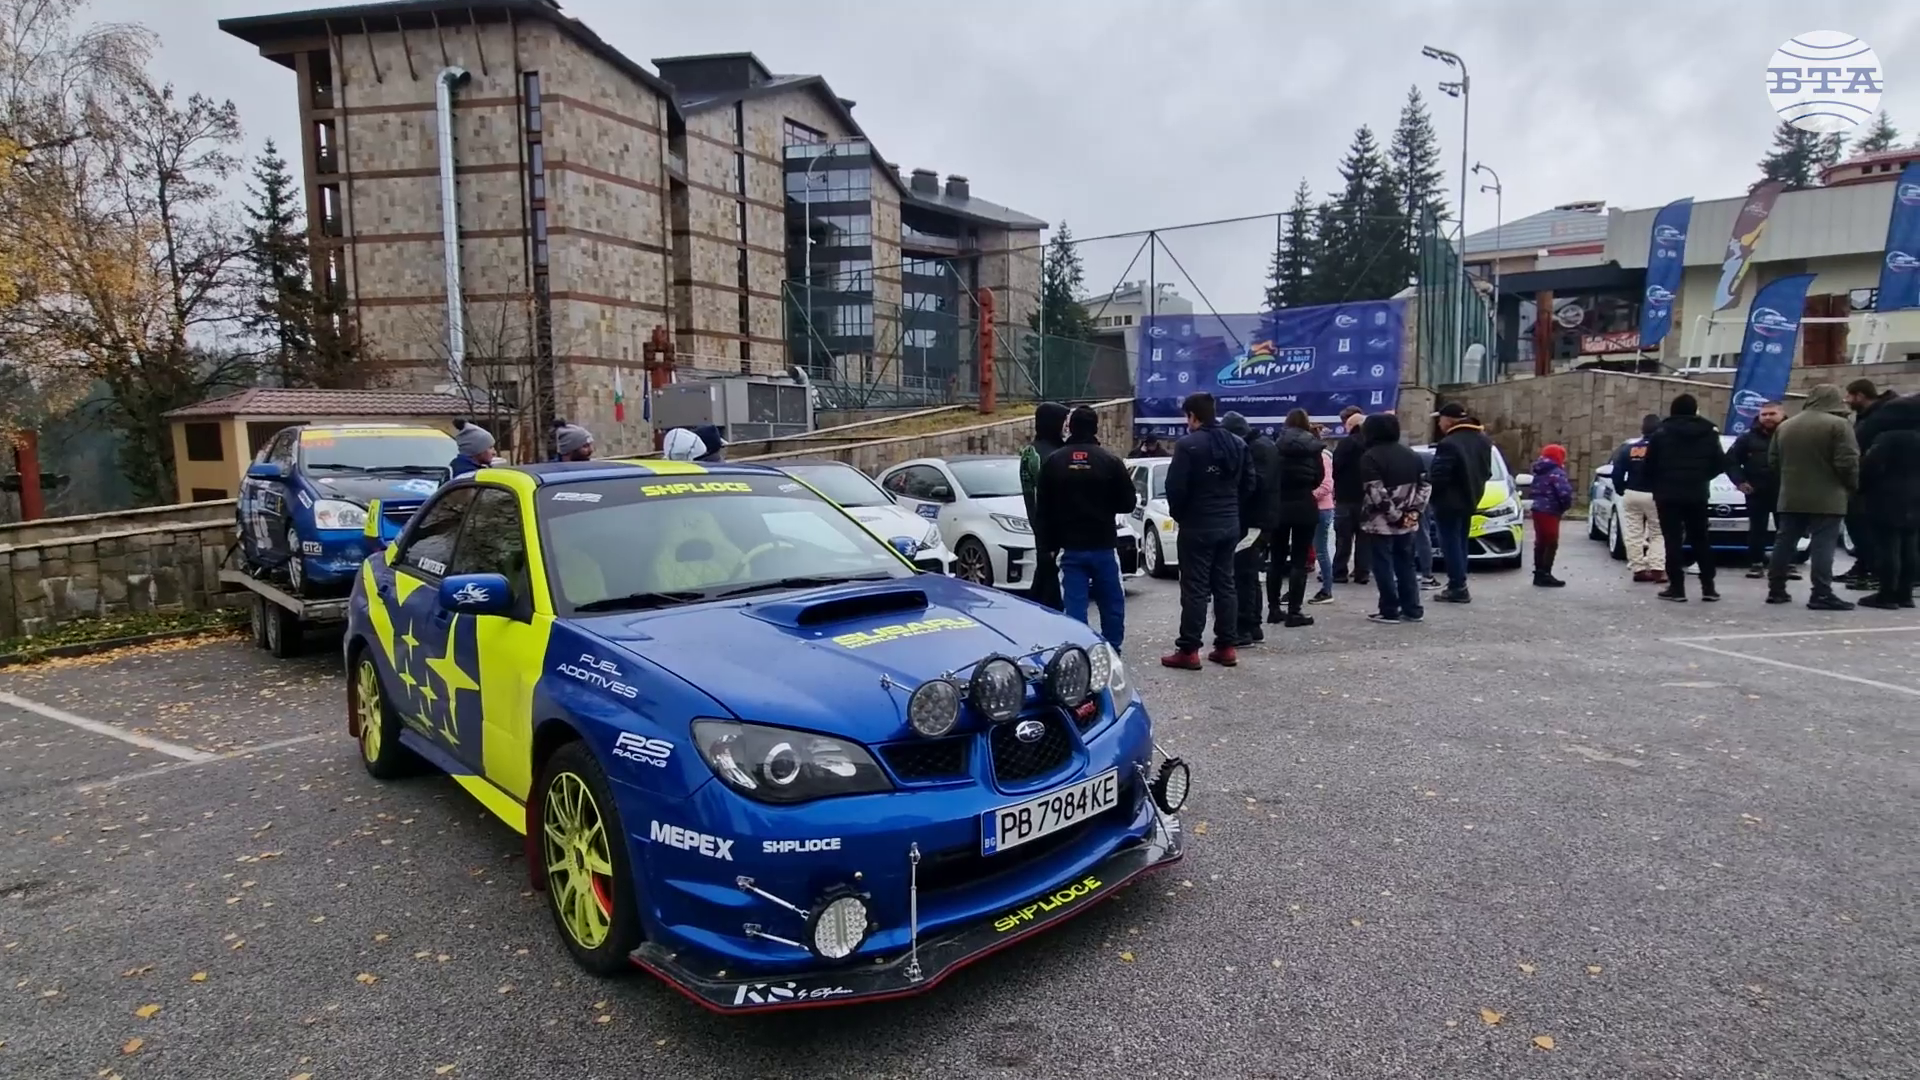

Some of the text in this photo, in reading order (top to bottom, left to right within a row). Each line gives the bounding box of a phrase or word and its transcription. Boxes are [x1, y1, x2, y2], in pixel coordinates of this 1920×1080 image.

[1765, 343, 1782, 354] FIA
[640, 482, 752, 496] SHPLIOCE
[832, 616, 973, 646] SUBARU
[579, 653, 622, 677] FUEL
[556, 663, 639, 699] ADDITIVES
[615, 731, 674, 759] PS
[612, 748, 667, 768] RACING
[1001, 775, 1115, 844] PB 7984 KE
[650, 820, 734, 862] MEPEX
[762, 837, 842, 853] SHPLIOCE
[984, 837, 996, 849] BG
[994, 875, 1102, 932] SHPLIOCE
[733, 981, 796, 1005] KS
